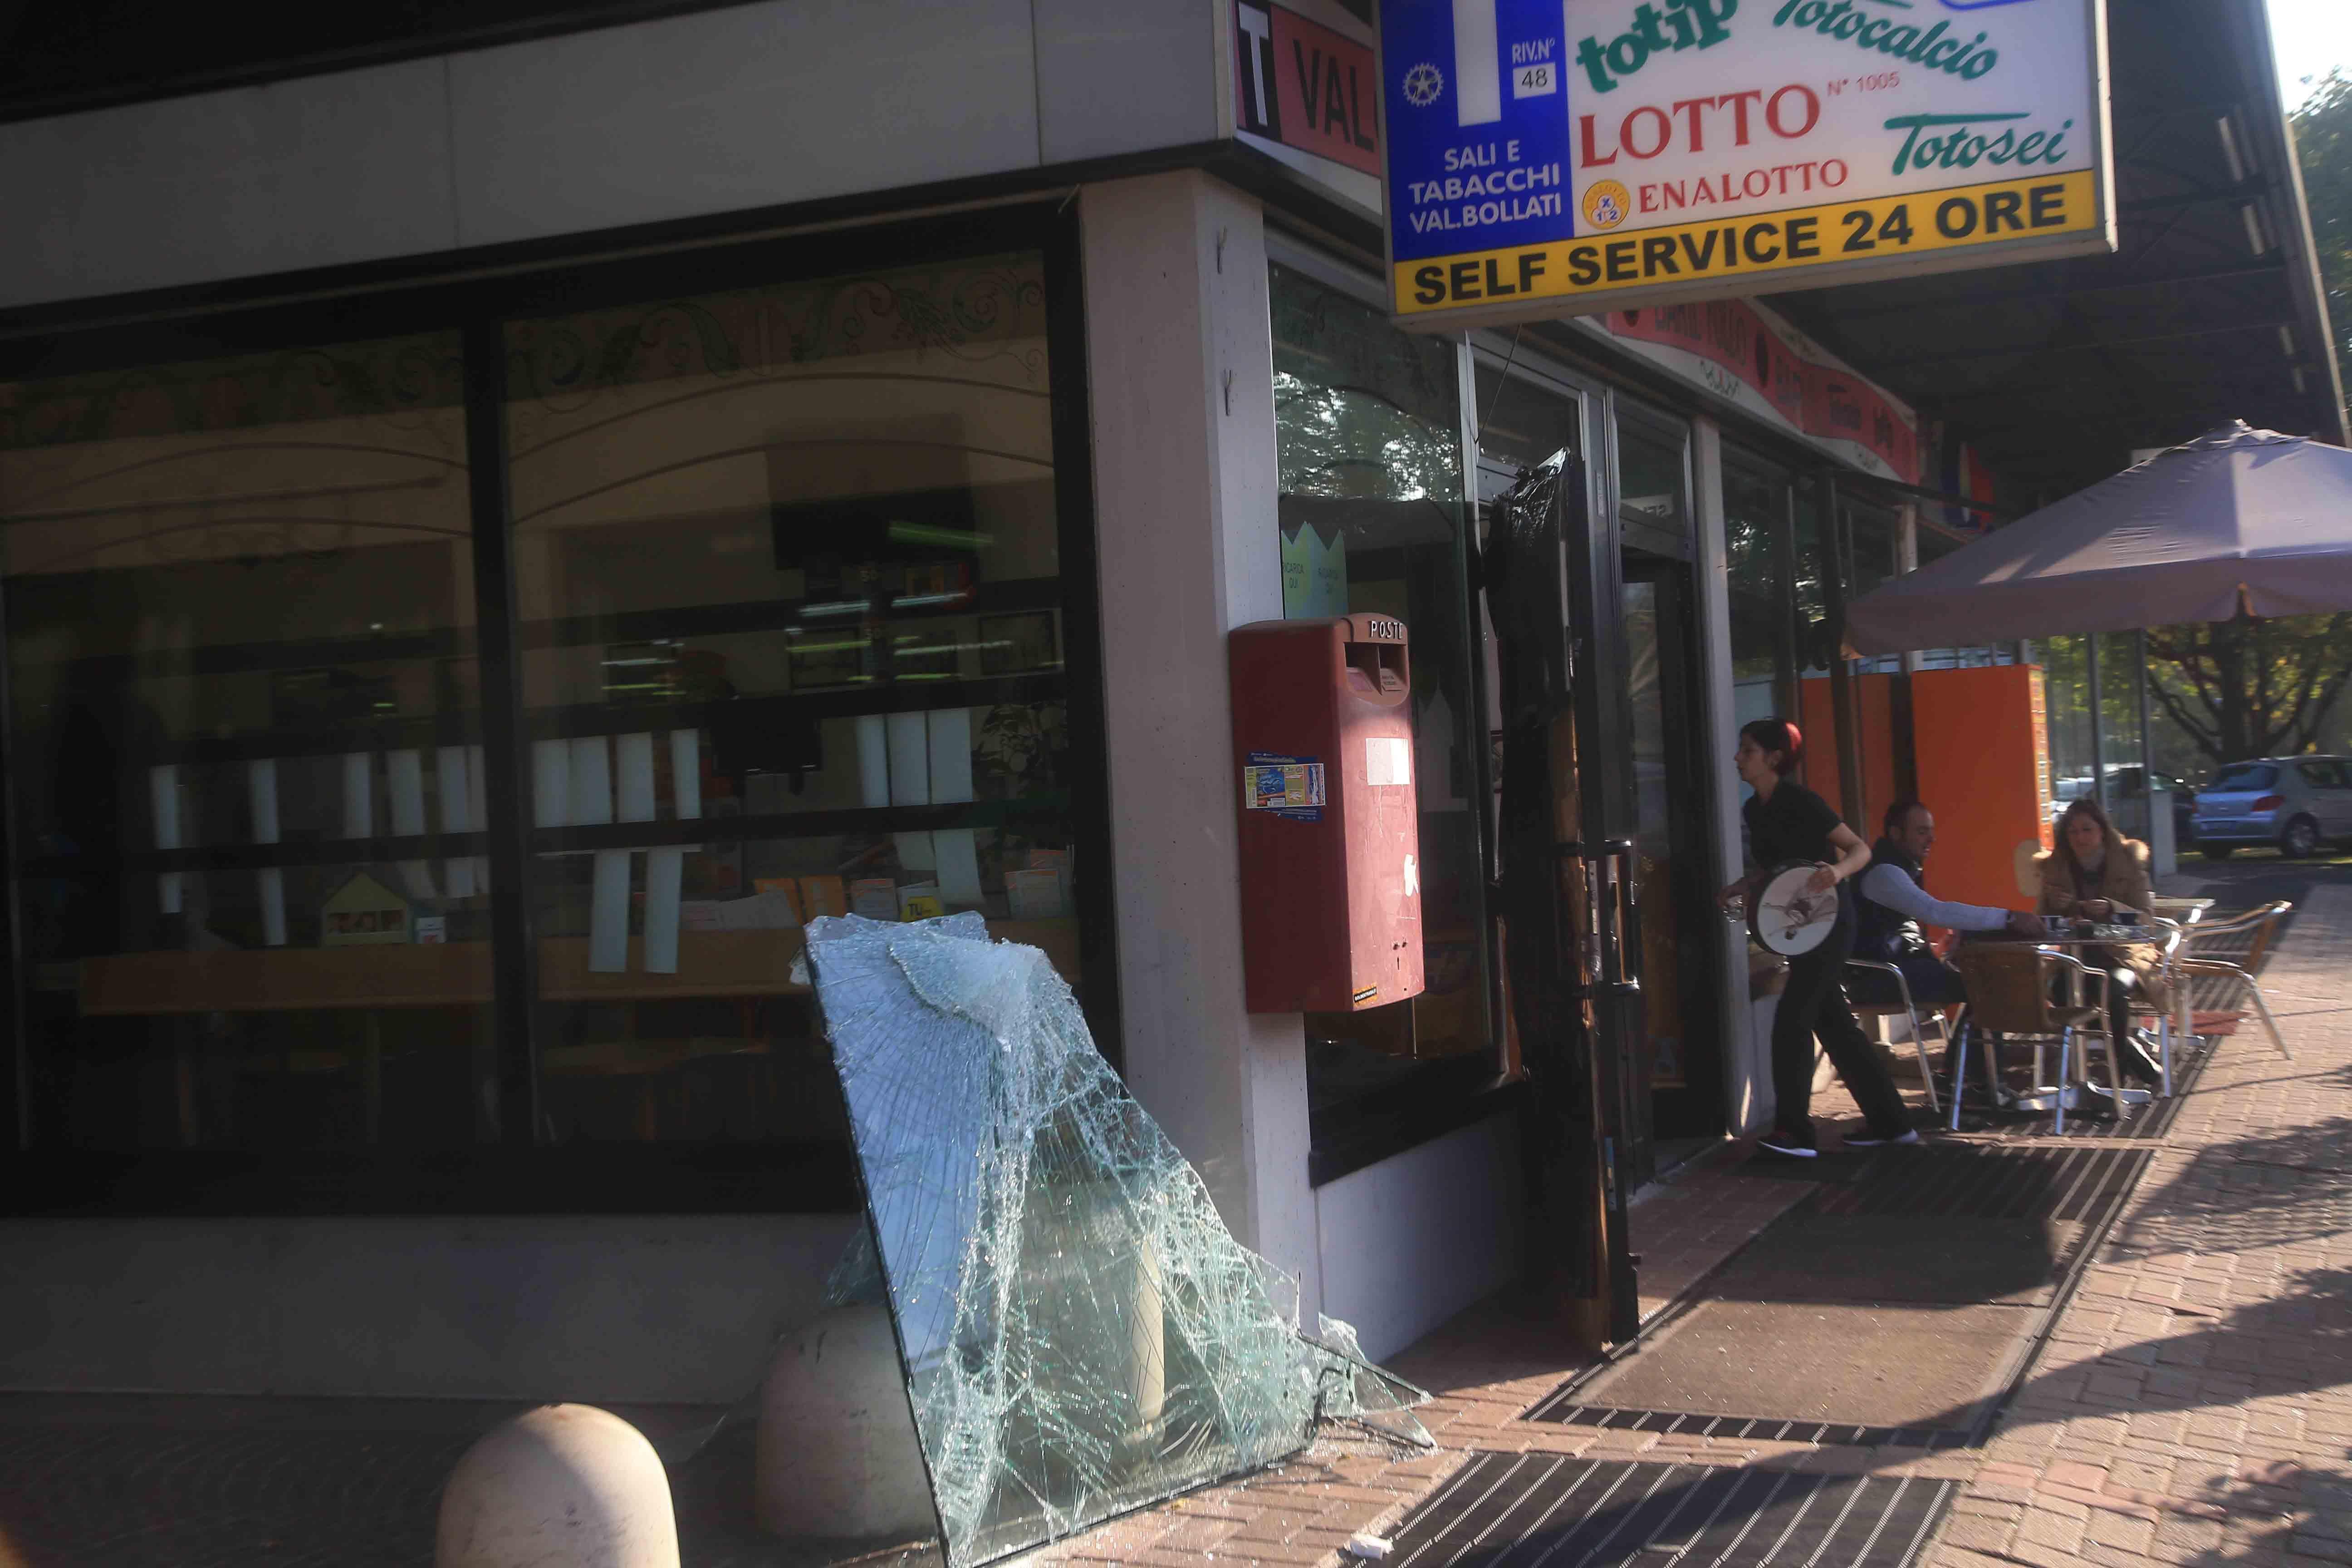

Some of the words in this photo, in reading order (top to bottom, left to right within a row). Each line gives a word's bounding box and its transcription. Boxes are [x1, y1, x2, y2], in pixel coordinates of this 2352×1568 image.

[1238, 1, 1269, 127] T
[1577, 0, 1740, 93] totip
[1293, 39, 1379, 153] VAL
[1521, 69, 1548, 89] 48
[1856, 71, 1901, 93] 1005
[1579, 84, 1821, 168] LOTTO
[1883, 112, 2073, 176] Totosei
[1445, 142, 1496, 171] SALI
[1507, 139, 1520, 162] E
[1409, 163, 1560, 205] TABACCHI
[1639, 158, 1848, 213] ENALOTTO
[1410, 193, 1562, 234] VAL.BOLLATI
[1414, 252, 1546, 306] SELF
[1568, 216, 1820, 286] SERVICE
[1842, 205, 1913, 252] 24
[1936, 183, 2067, 239] ORE
[1369, 620, 1404, 640] POSTE
